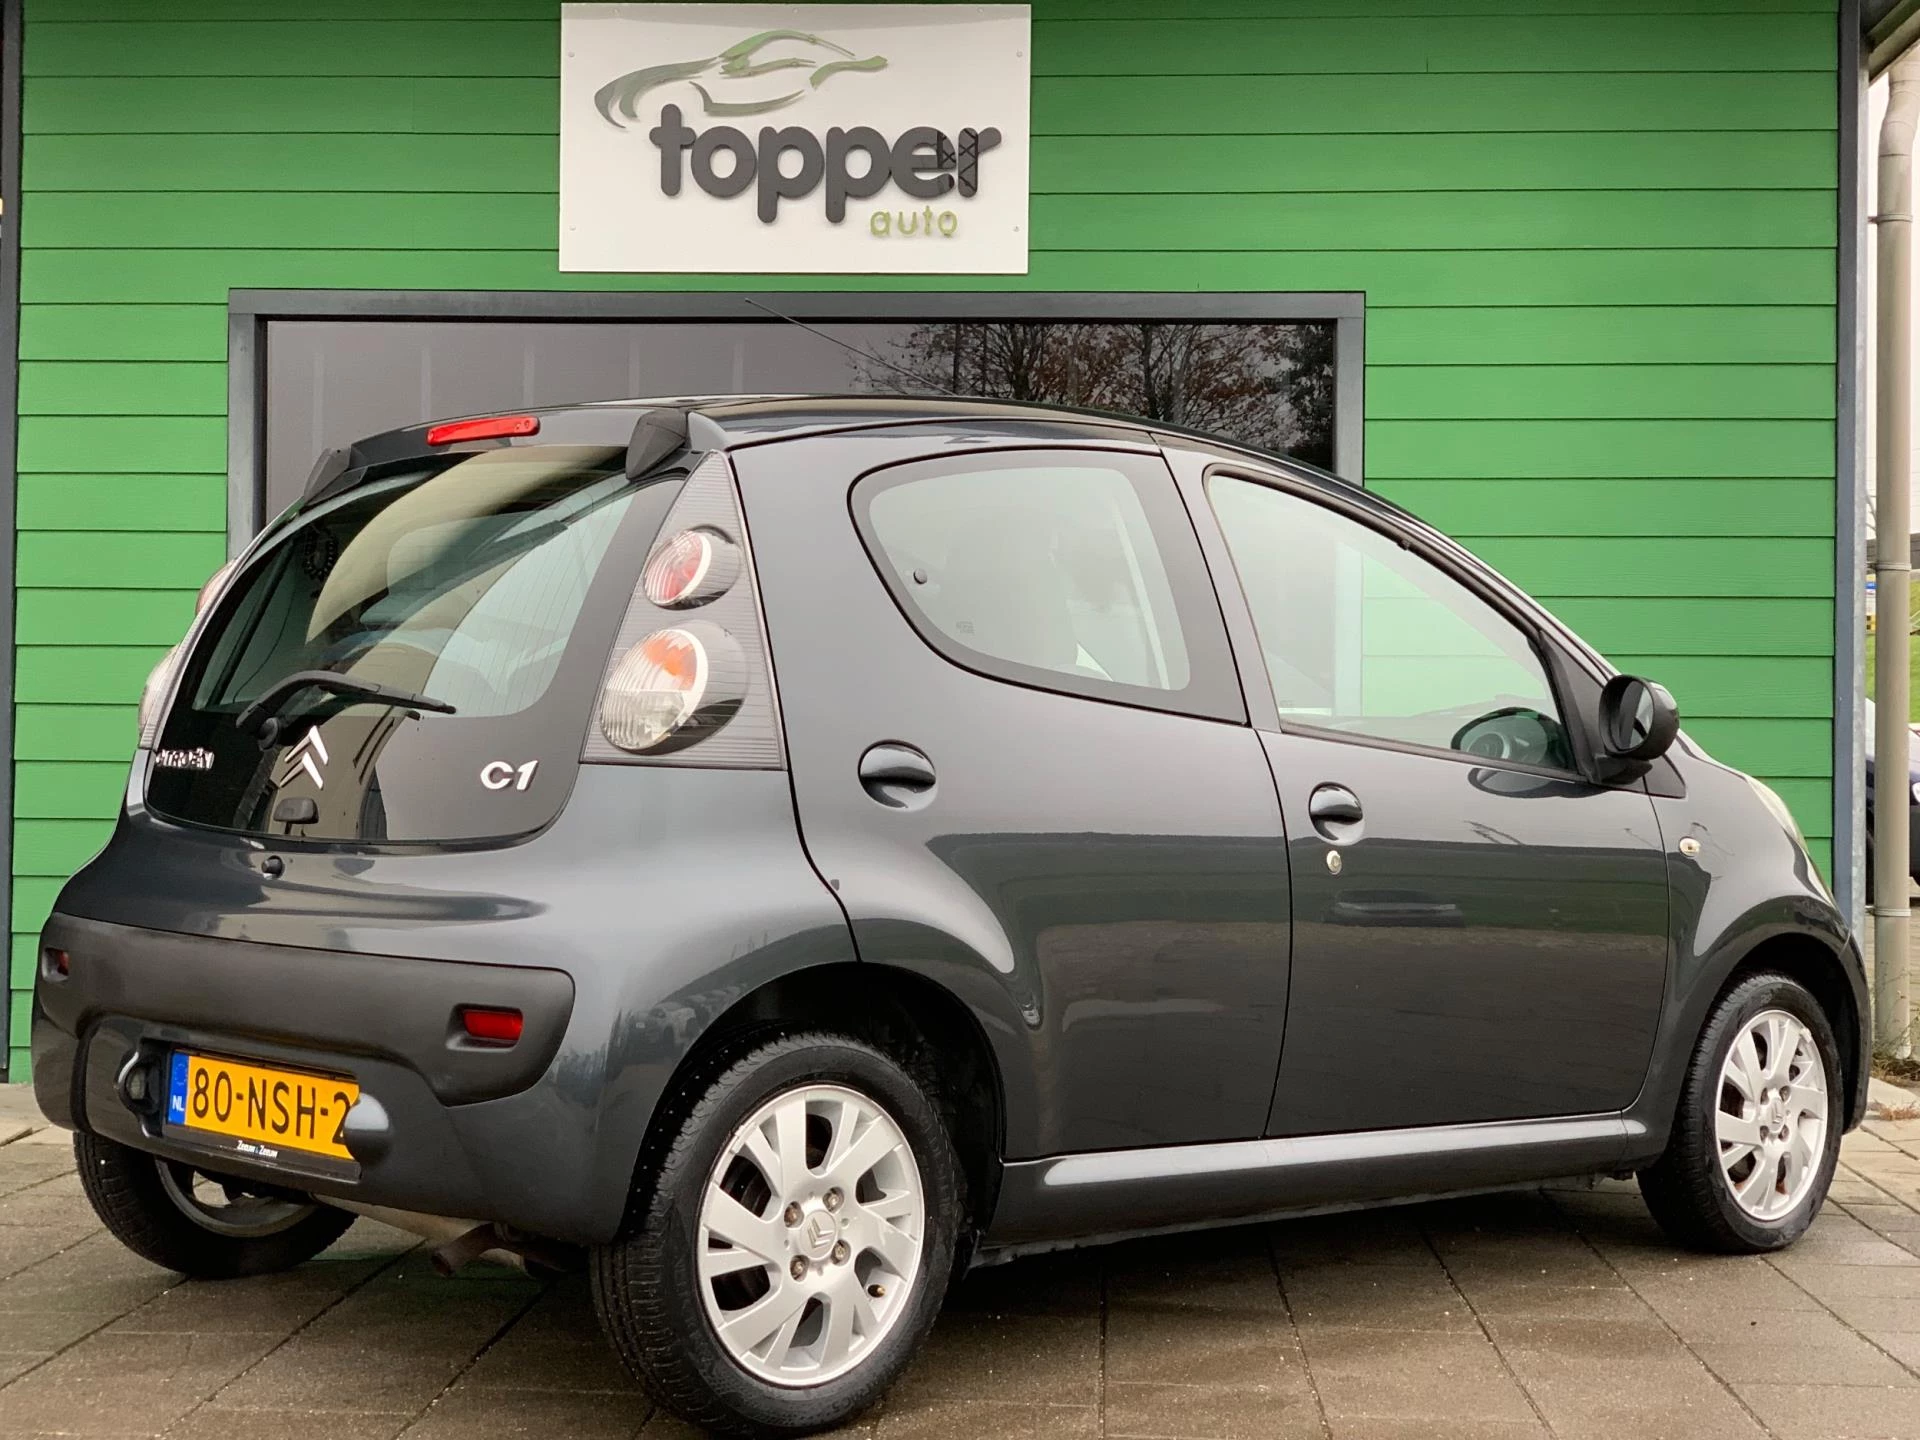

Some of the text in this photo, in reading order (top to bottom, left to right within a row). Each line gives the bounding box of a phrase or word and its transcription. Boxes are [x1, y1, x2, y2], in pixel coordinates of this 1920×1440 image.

[649, 103, 1002, 224] topper
[869, 206, 958, 237] auto
[480, 760, 538, 790] C1
[172, 1095, 184, 1111] NL
[192, 1067, 351, 1146] 80-NSH-2
